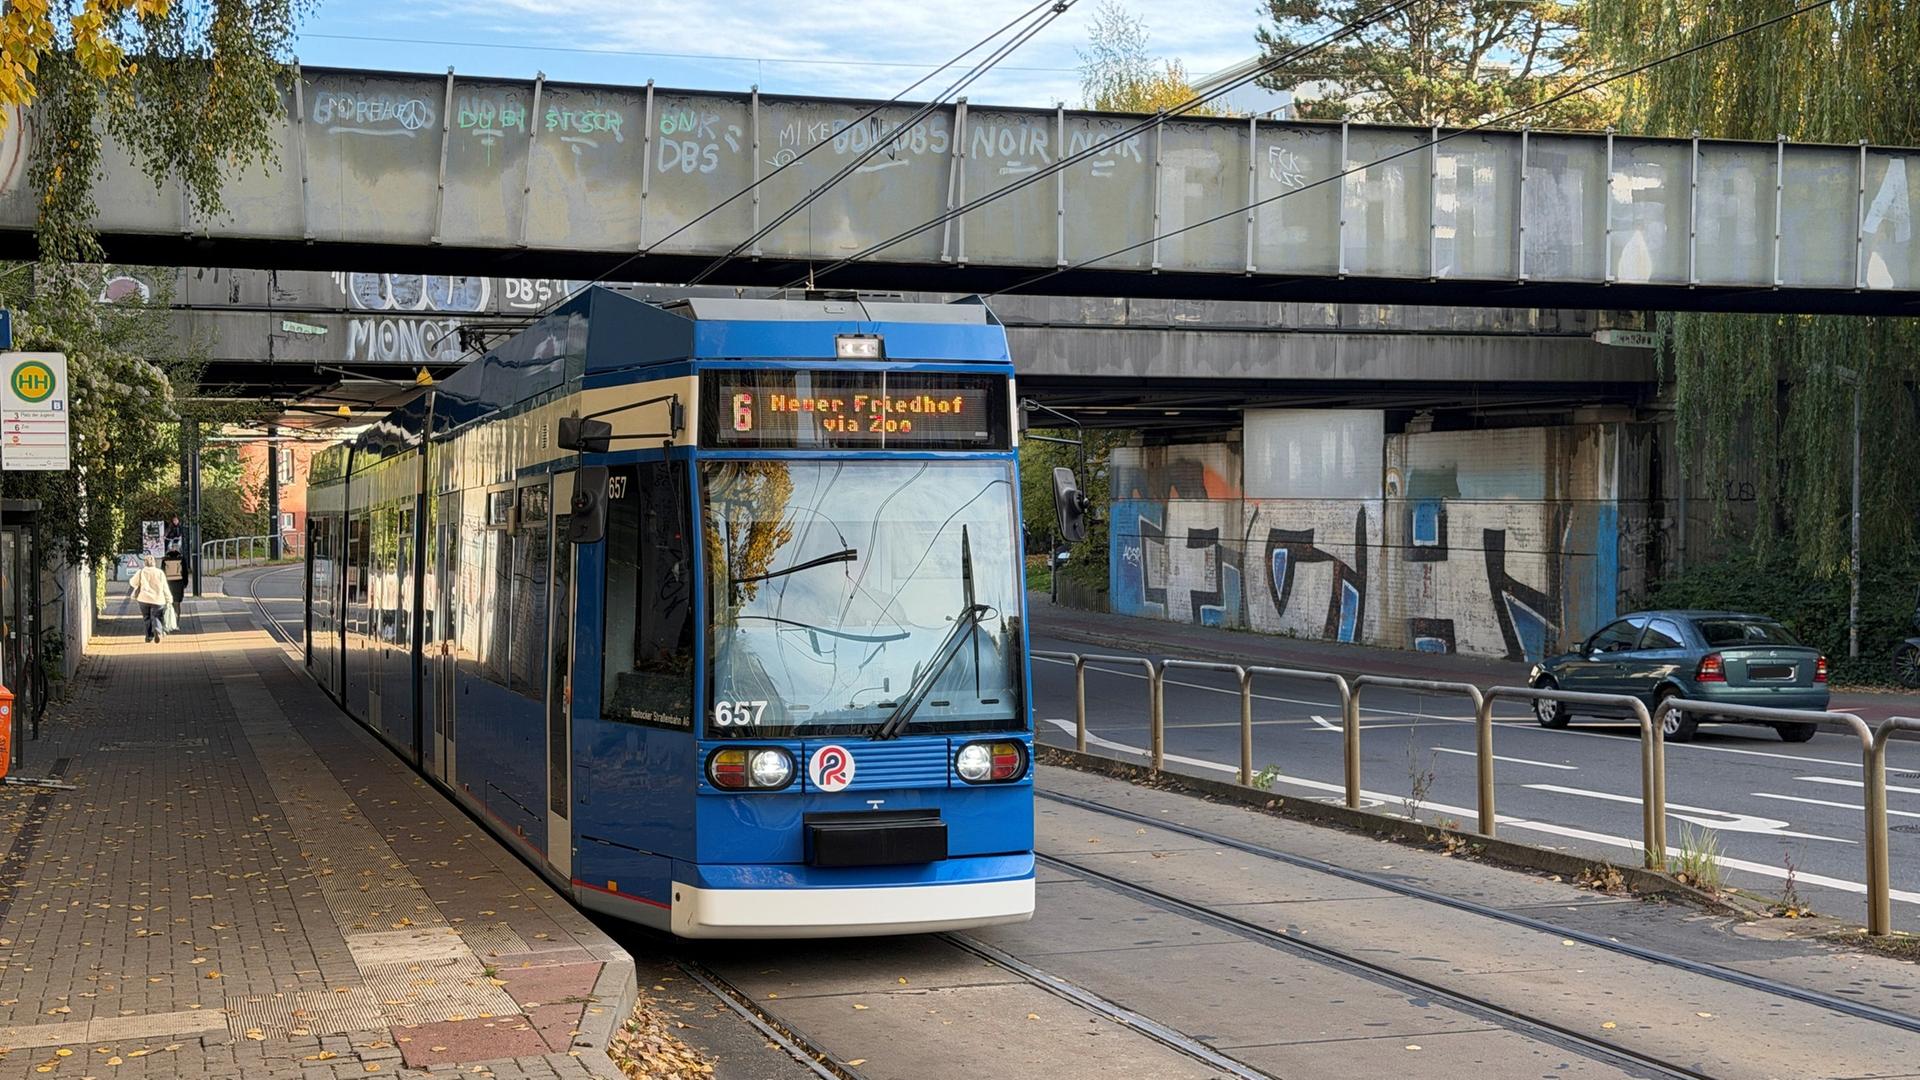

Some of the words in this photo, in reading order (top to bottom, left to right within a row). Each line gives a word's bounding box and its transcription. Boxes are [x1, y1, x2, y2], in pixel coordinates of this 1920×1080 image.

[779, 119, 830, 148] MIKE
[971, 121, 1051, 164] NOIR
[1068, 128, 1142, 164] NOIR
[658, 136, 720, 173] DBS
[1268, 145, 1301, 173] FCK
[505, 278, 552, 301] DBS
[14, 412, 19, 420] 3
[733, 393, 753, 432] 6
[770, 394, 844, 413] Neuer
[854, 394, 963, 414] Friedhof
[823, 415, 859, 432] via
[869, 415, 912, 433] Zoo
[608, 475, 627, 499] 657
[631, 707, 653, 721] Rostocker
[653, 710, 682, 726] Straßenbahn
[682, 716, 690, 727] AG
[715, 700, 768, 726] 657
